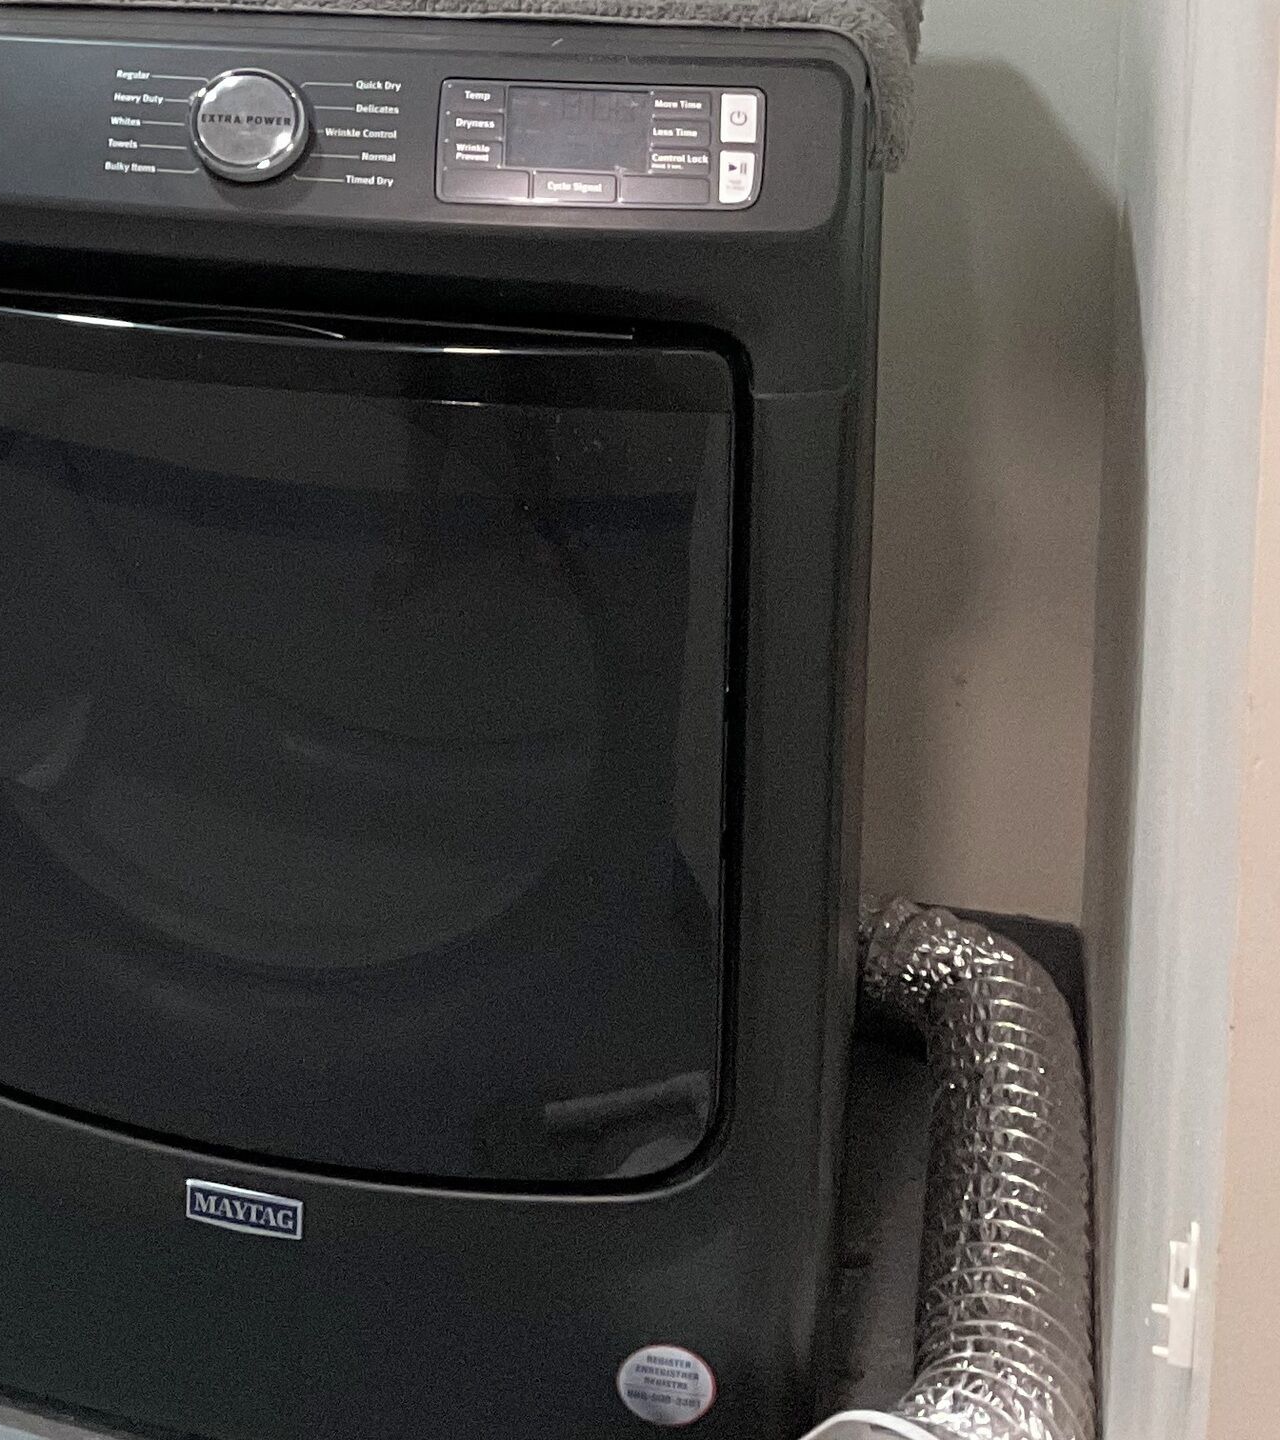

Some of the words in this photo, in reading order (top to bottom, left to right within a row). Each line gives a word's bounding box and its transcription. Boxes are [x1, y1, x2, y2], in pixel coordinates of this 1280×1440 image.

[116, 69, 151, 81] Regular
[355, 80, 383, 90] Quick
[384, 81, 402, 92] Dry
[113, 92, 141, 104] Heavy
[142, 93, 164, 105] Duty
[464, 90, 491, 101] Temp
[355, 104, 400, 114] Delicates
[654, 99, 678, 109] More
[679, 100, 702, 109] Time
[110, 116, 141, 127] Whites
[201, 113, 241, 124] EXTRA
[246, 115, 291, 126] POWER
[455, 117, 496, 129] Dryness
[325, 127, 360, 138] Wrinkle
[362, 129, 397, 139] Control
[652, 127, 674, 136] Less
[675, 127, 698, 137] Time
[108, 138, 138, 149] Towels
[455, 143, 490, 152] Wrinkle
[361, 151, 396, 162] Normal
[651, 153, 686, 163] Control
[686, 154, 709, 164] Lock
[104, 161, 130, 173] Bulky
[131, 163, 156, 173] Items
[345, 174, 375, 185] Timed
[376, 175, 394, 187] Dry
[547, 180, 571, 191] Cycle
[572, 182, 603, 193] Signal
[193, 1191, 295, 1231] MAYTAG
